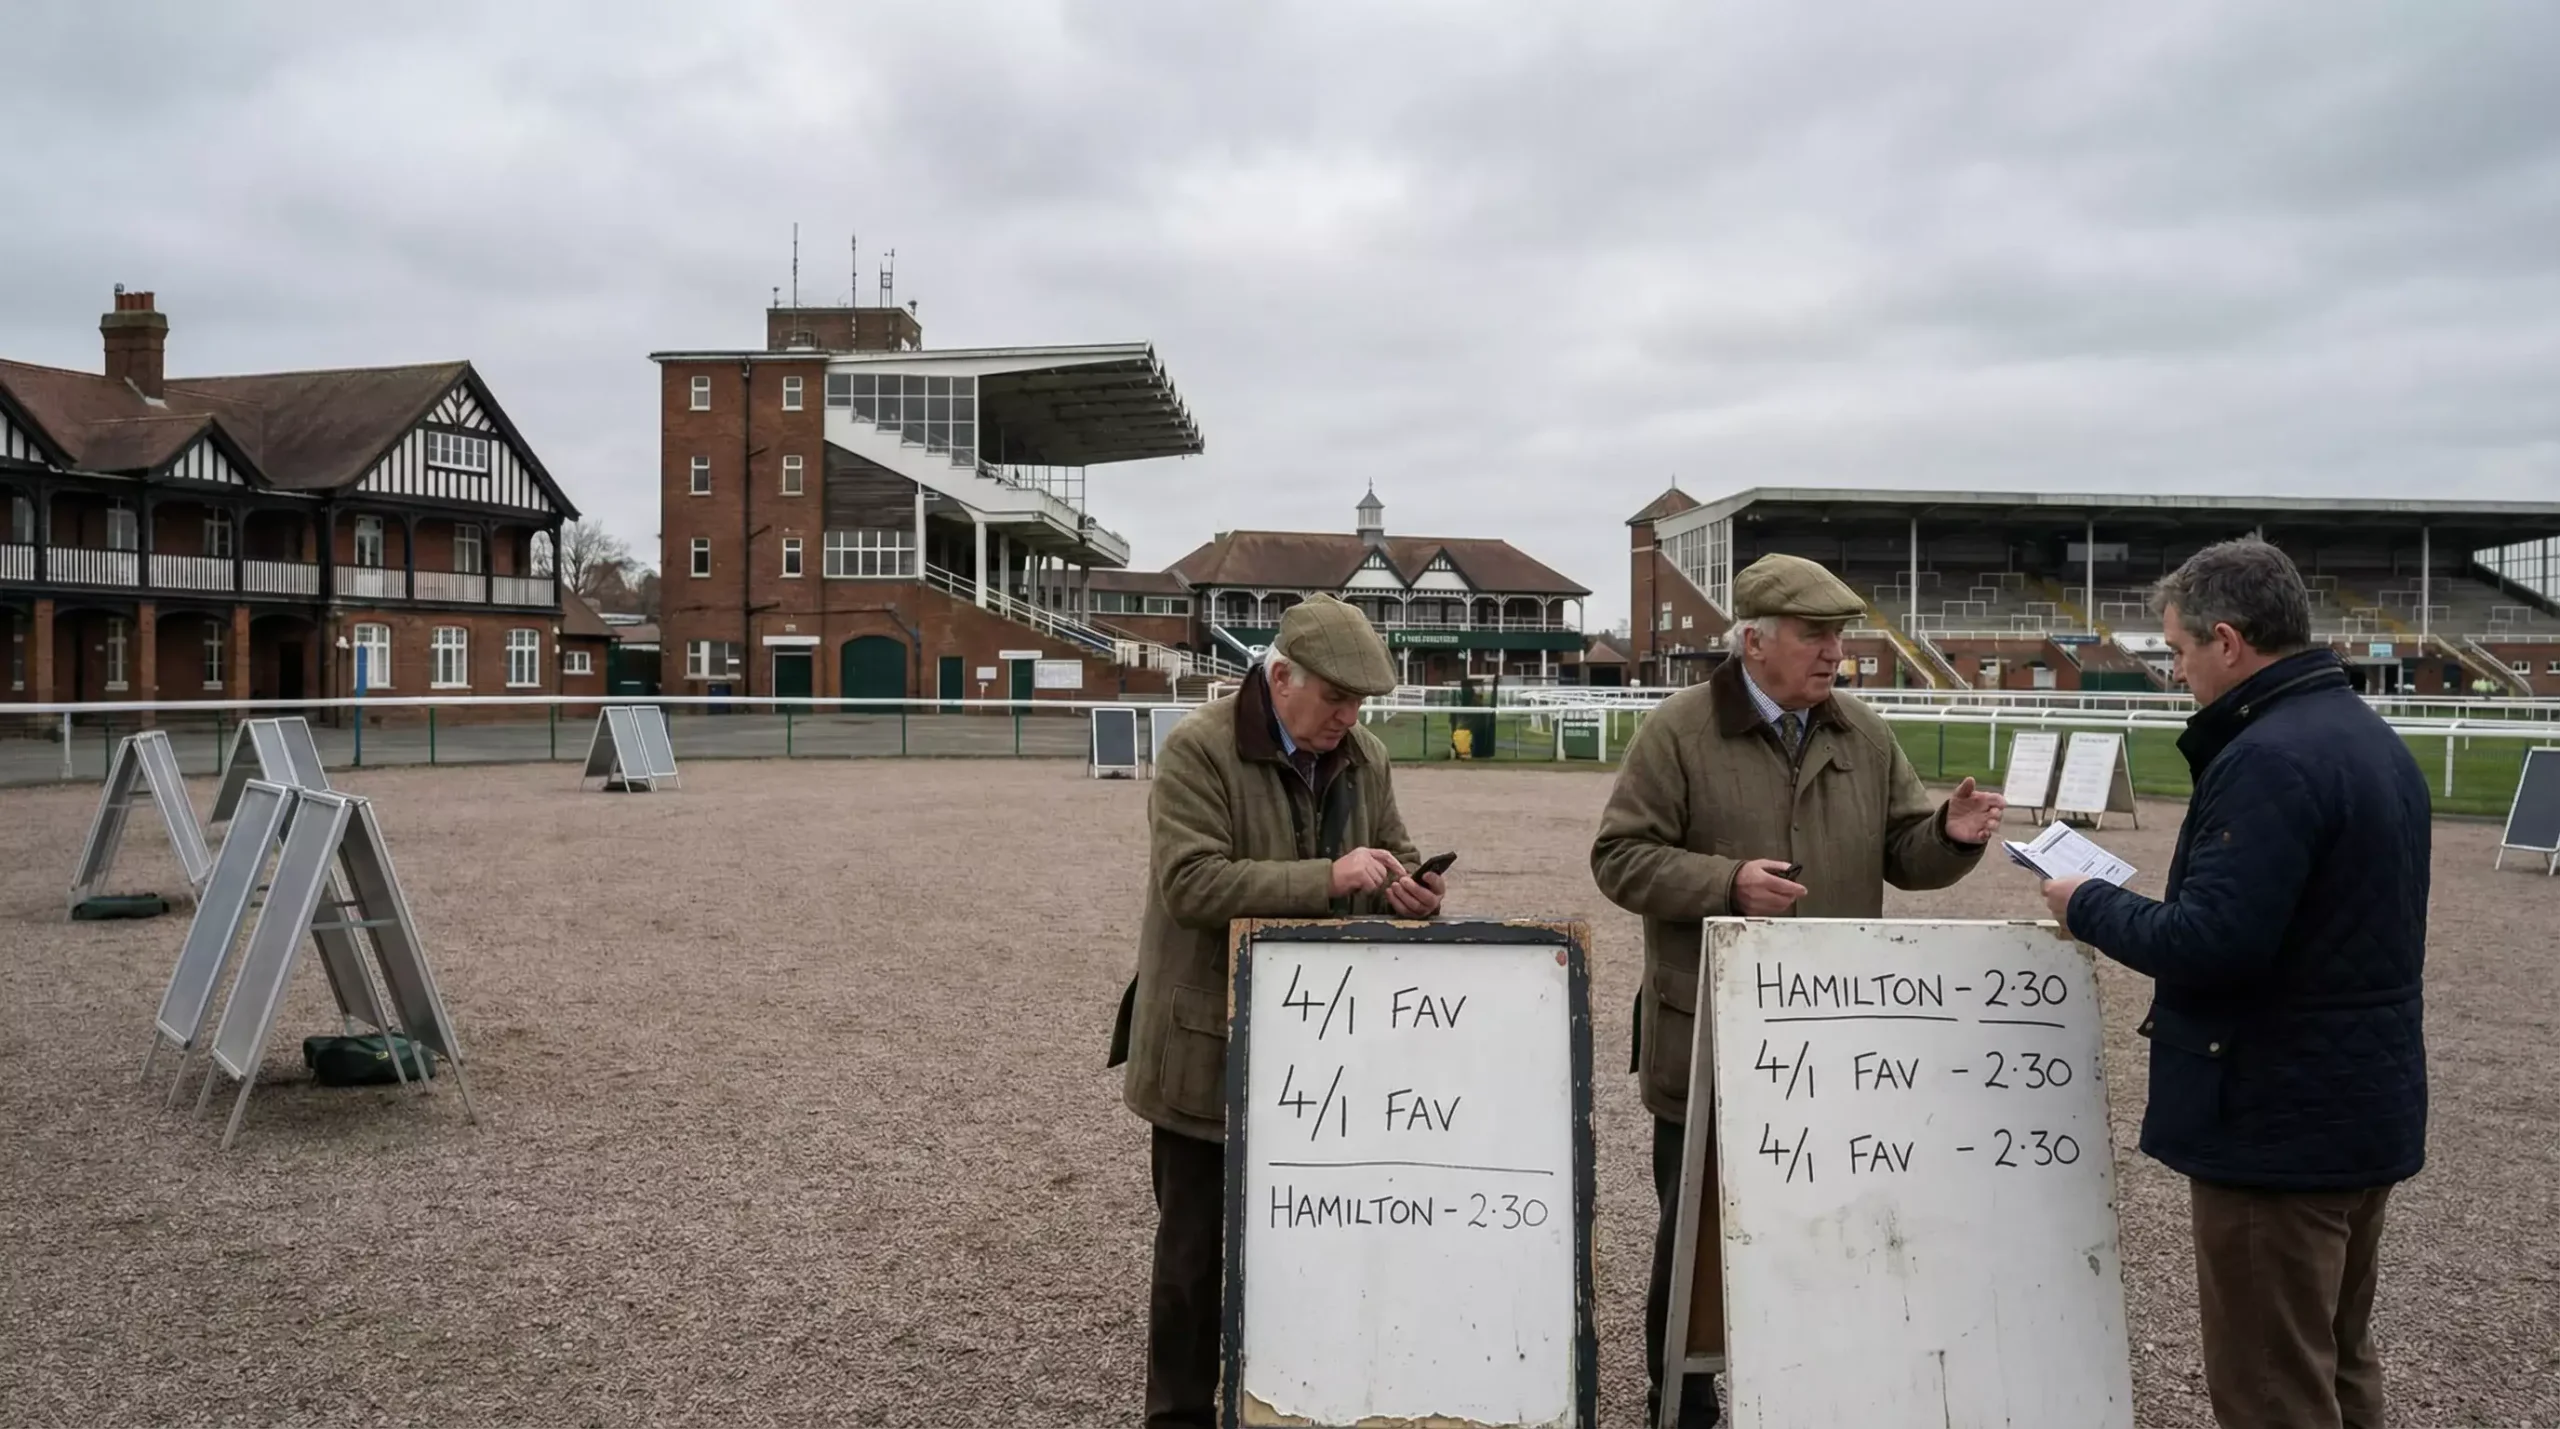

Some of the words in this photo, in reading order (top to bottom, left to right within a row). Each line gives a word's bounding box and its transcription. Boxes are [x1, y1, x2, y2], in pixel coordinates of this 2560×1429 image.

[1281, 963, 1355, 1041] 4/1
[1391, 986, 1467, 1029] FAV
[1756, 961, 1943, 1009] HAMILTON
[1754, 1038, 1815, 1101] 4/1
[1853, 1051, 1920, 1091] FAV
[1277, 1063, 1347, 1143] 4/1
[1385, 1088, 1462, 1132] FAV
[1758, 1122, 1814, 1184] 4/1
[1848, 1133, 1915, 1175] FAV
[1270, 1184, 1433, 1229] HAMILTON
